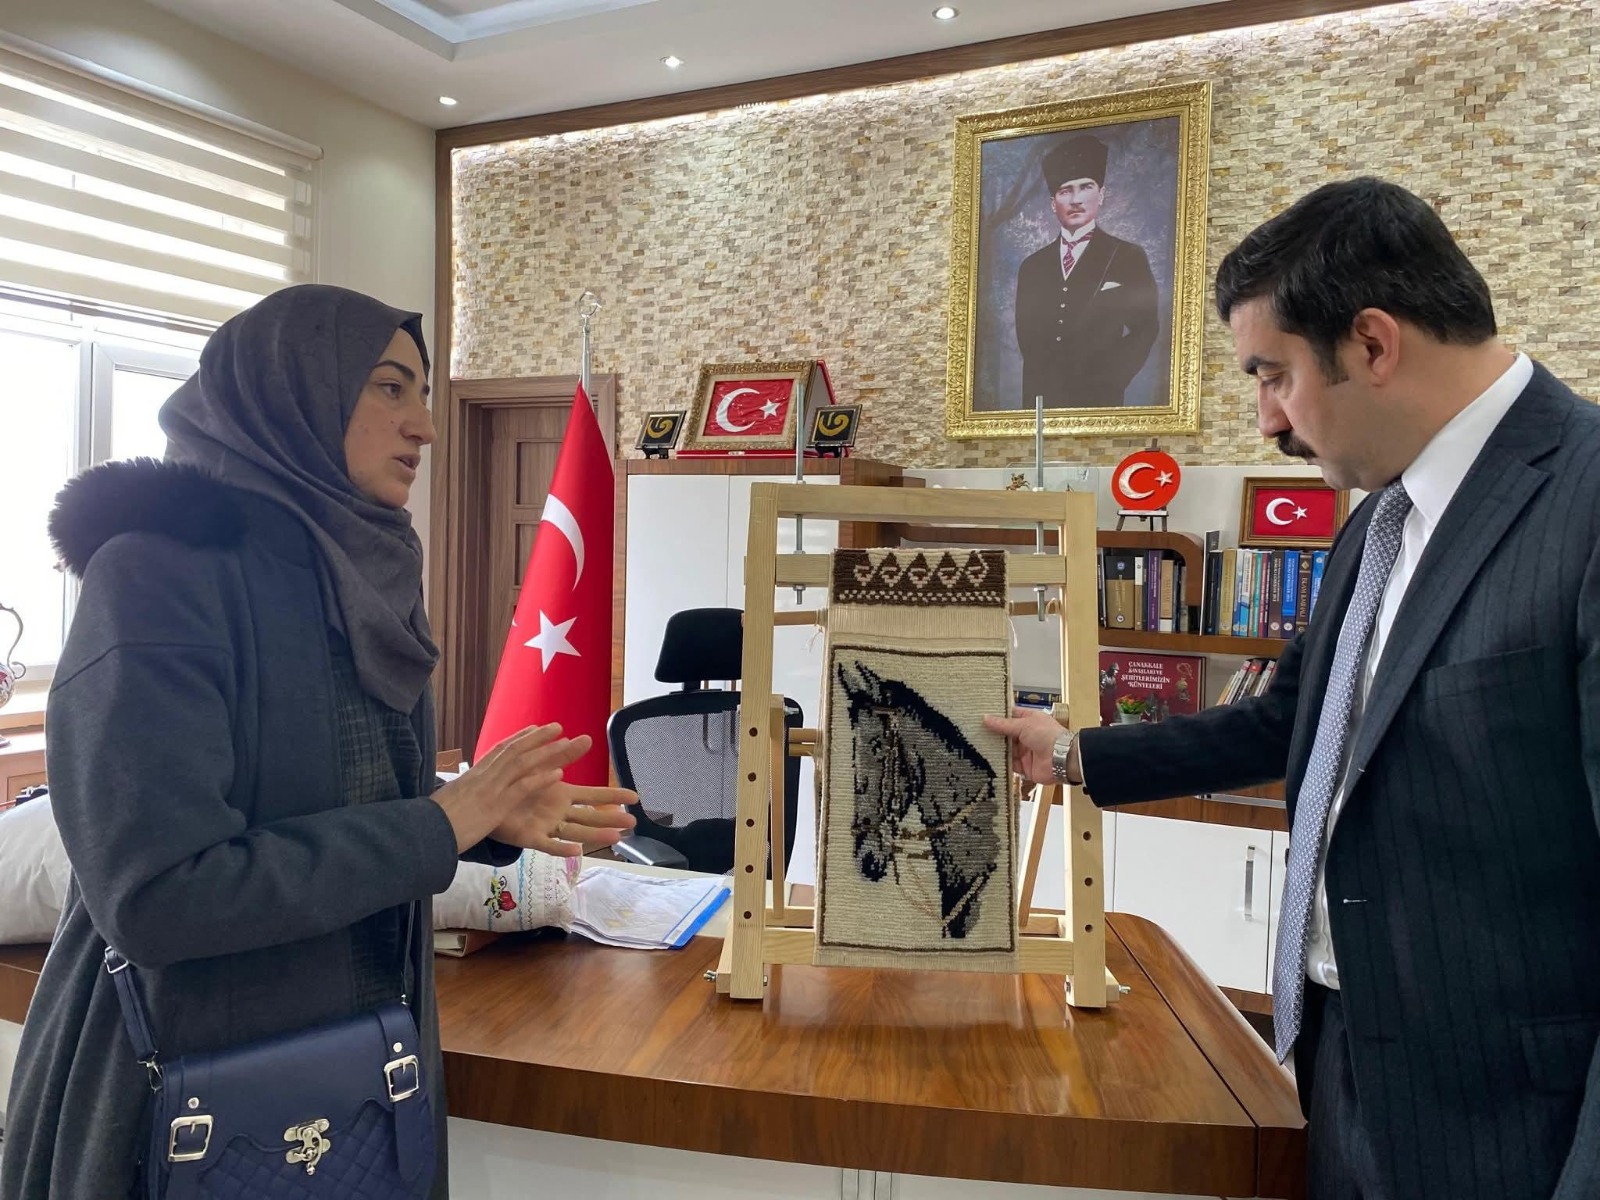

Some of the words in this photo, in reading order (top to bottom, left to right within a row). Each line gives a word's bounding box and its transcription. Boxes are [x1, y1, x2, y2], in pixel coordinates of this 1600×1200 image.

[1128, 661, 1163, 669] ÇANAKKALE
[1121, 674, 1170, 683] ŞEHİTLERİMİZİN
[1127, 681, 1163, 689] KÜNYELERİ
